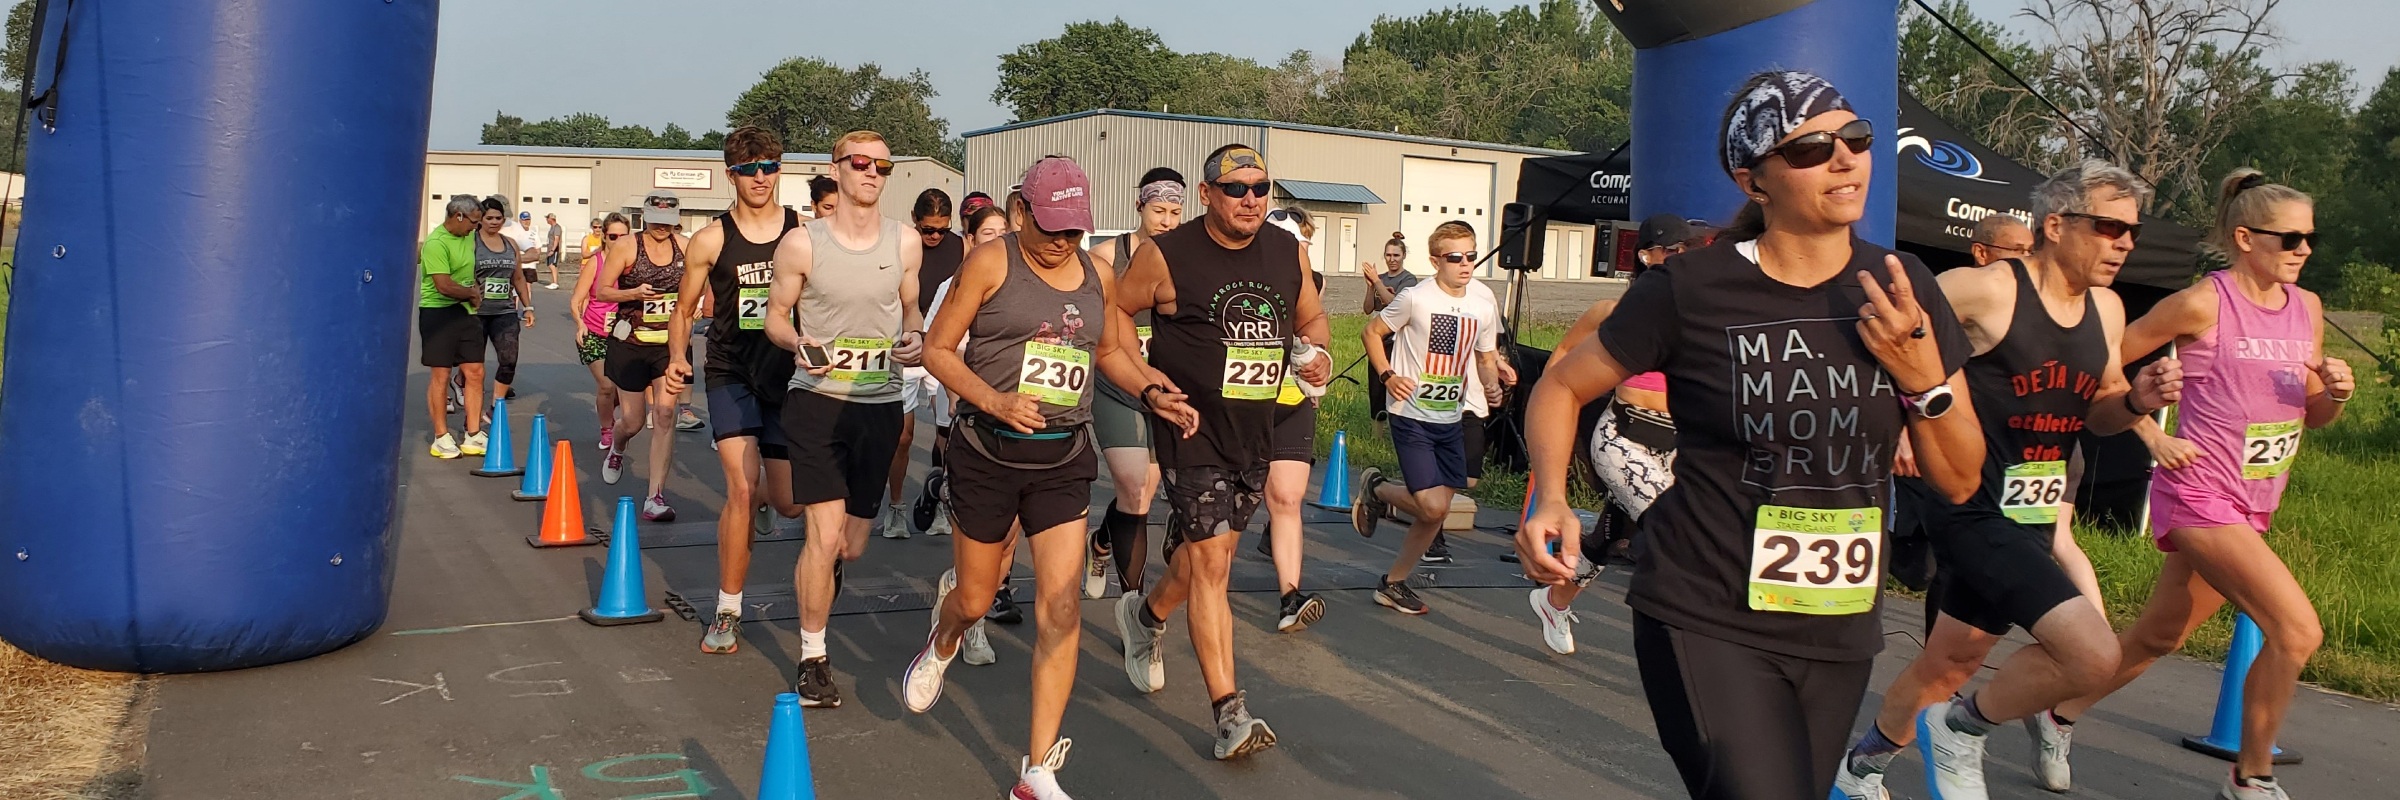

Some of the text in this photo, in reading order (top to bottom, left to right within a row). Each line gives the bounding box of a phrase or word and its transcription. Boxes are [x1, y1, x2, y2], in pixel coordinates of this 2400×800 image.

[1051, 192, 1071, 202] NATIVE
[736, 261, 767, 276] MILES
[738, 269, 774, 284] MILE
[486, 283, 509, 294] 228
[1208, 281, 1244, 322] SHAMROCK
[1248, 281, 1271, 292] RUN
[1228, 321, 1274, 339] YRR
[1053, 346, 1067, 354] SKY
[1737, 328, 1825, 365] MA.
[834, 349, 886, 371] 211
[1024, 358, 1085, 391] 230
[1227, 361, 1279, 385] 229
[1418, 383, 1460, 400] 226
[1742, 406, 1867, 442] MOM.
[2008, 413, 2085, 432] athletic
[2023, 445, 2061, 461] club
[2248, 432, 2299, 464] 237
[2004, 478, 2062, 506] 236
[1779, 509, 1806, 521] BIG
[1811, 512, 1838, 523] SKY
[1775, 521, 1837, 533] STATE GAMES
[1758, 534, 1873, 585] 239
